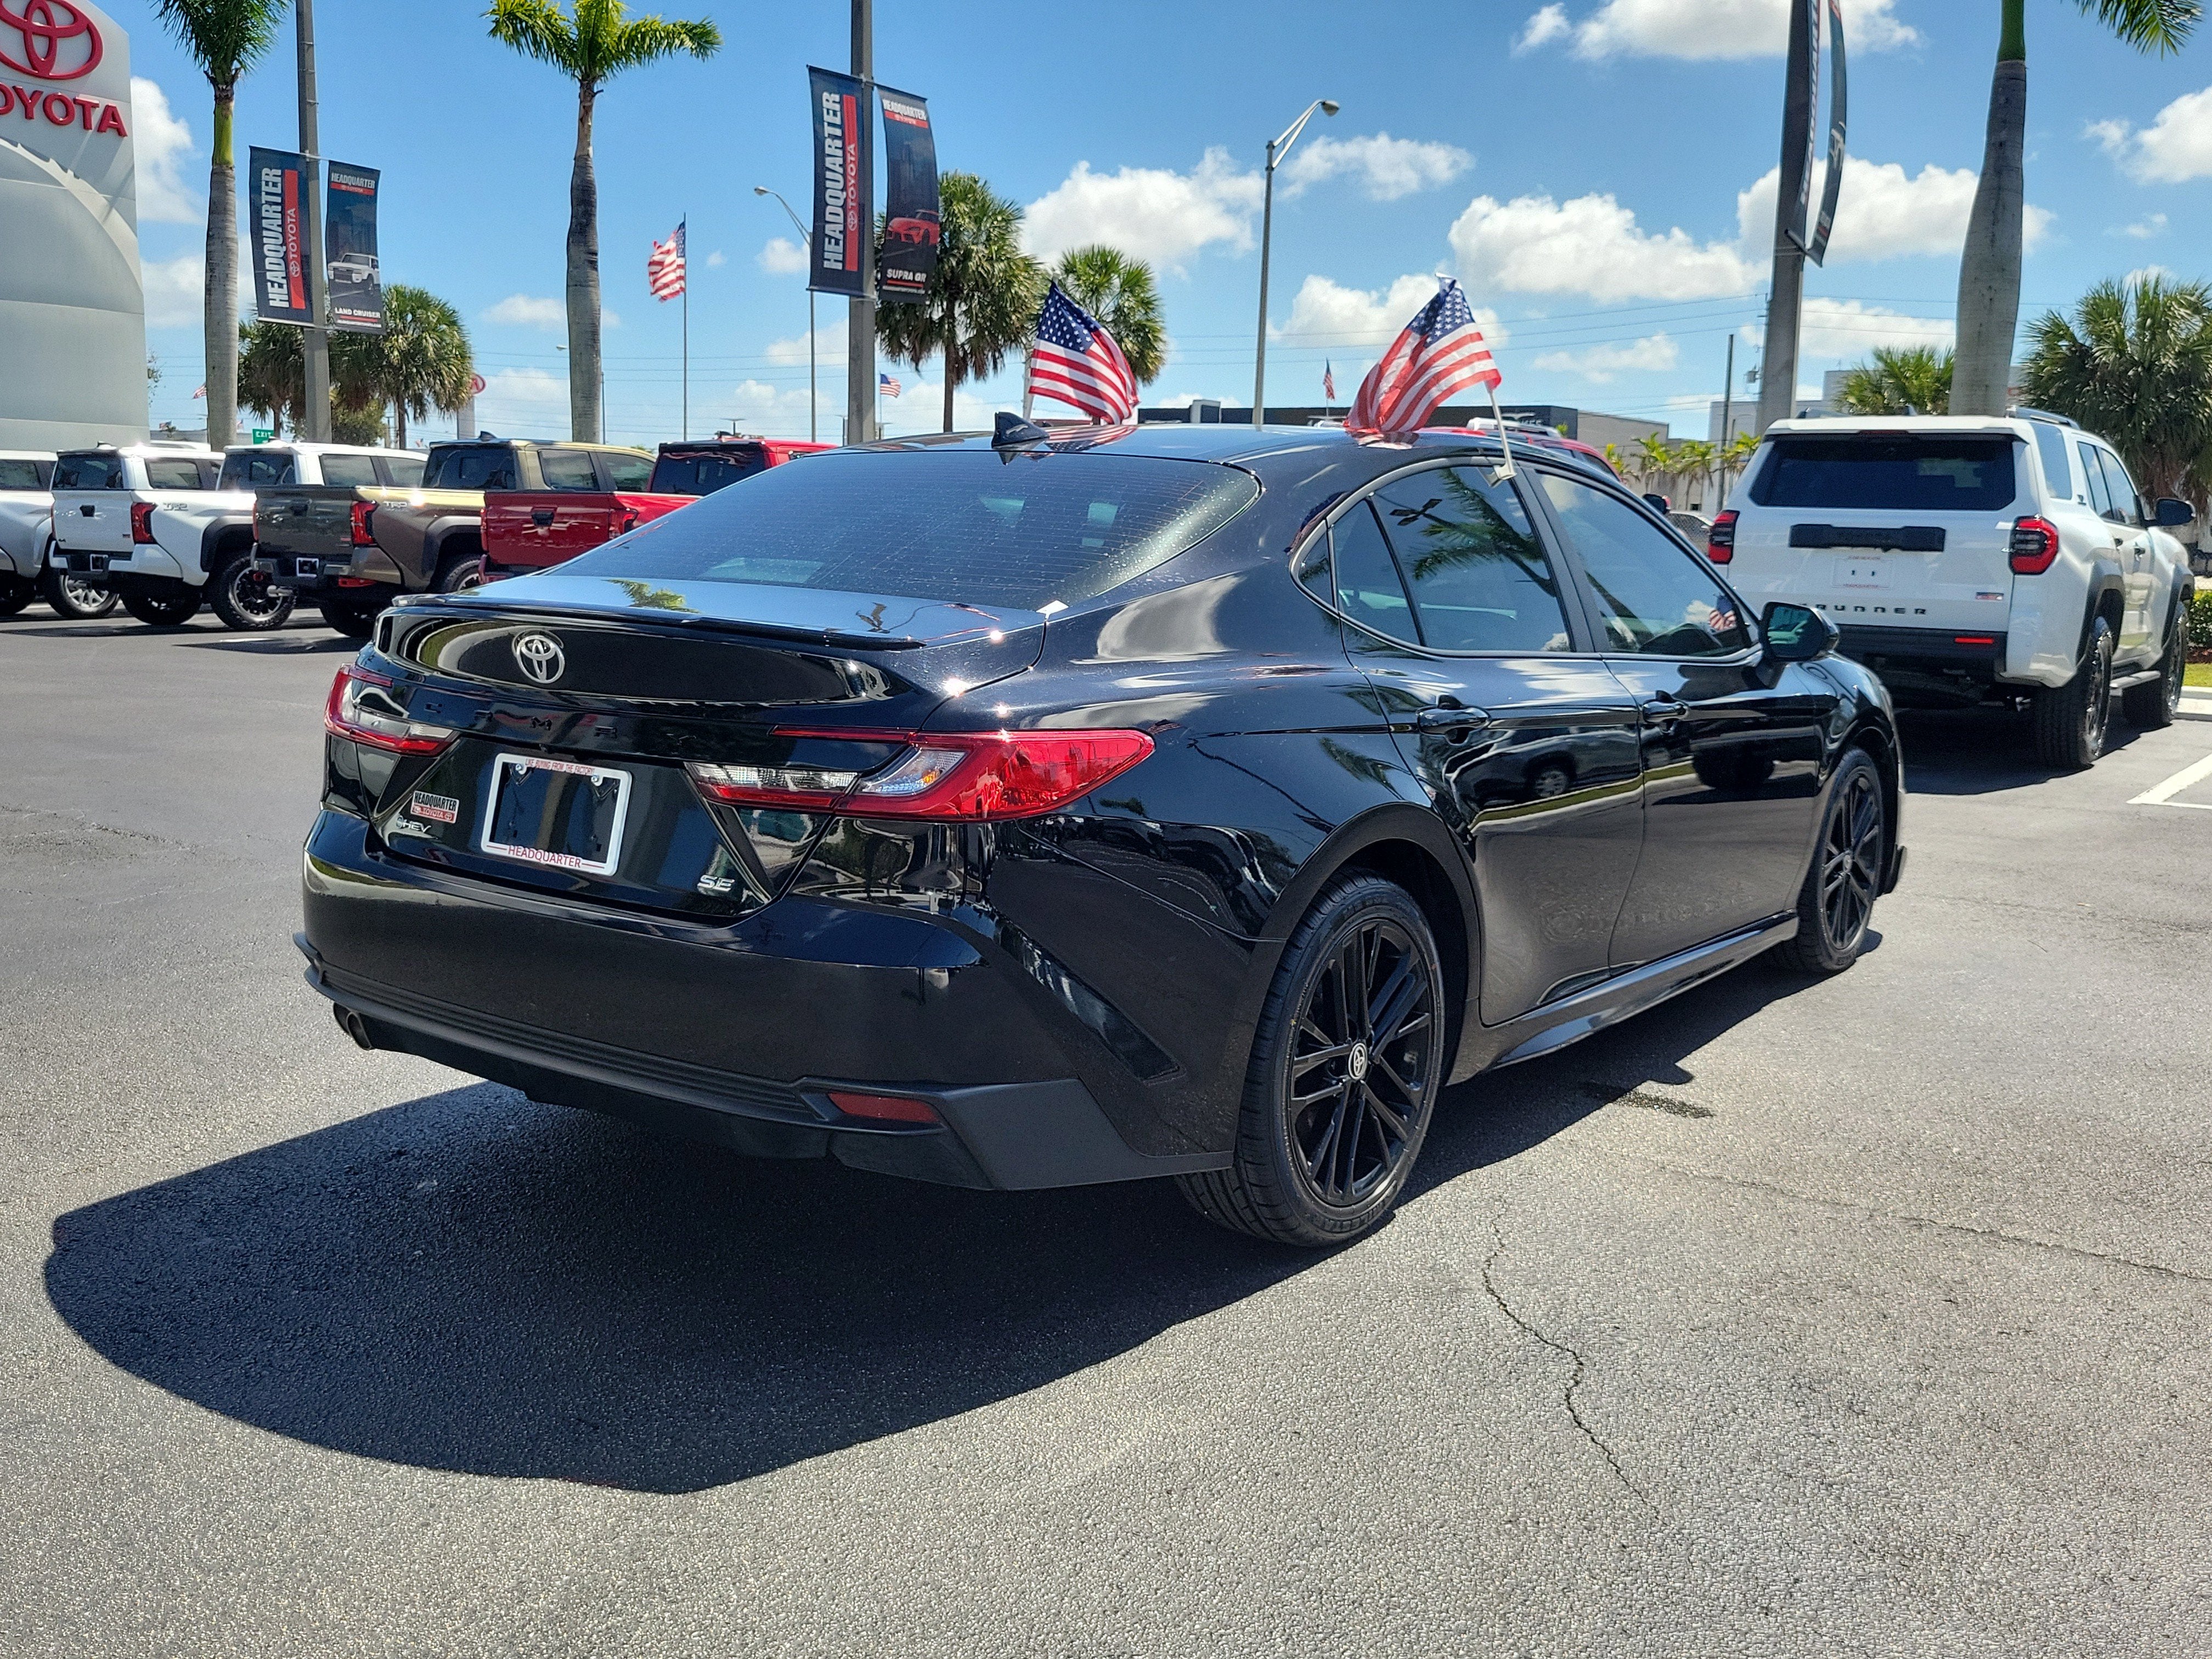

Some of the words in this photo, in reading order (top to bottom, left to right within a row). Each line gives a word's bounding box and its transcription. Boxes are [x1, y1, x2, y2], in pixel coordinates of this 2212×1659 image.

[331, 172, 375, 189] HEADQUARTER
[822, 92, 847, 270] HEADQUARTER
[848, 144, 856, 208] TOYOTA
[261, 167, 290, 308] HEADQUARTER
[287, 208, 298, 259] TOYOTA
[887, 268, 913, 281] SUPRA
[914, 273, 927, 282] GR
[335, 307, 352, 315] LAND
[353, 309, 381, 318] CRUISER
[1799, 603, 1926, 615] RUNNER
[414, 792, 458, 812] HEADQUARTER
[422, 807, 443, 819] TOYOTA
[508, 845, 581, 868] HEADQUARTER
[697, 874, 735, 891] SE
